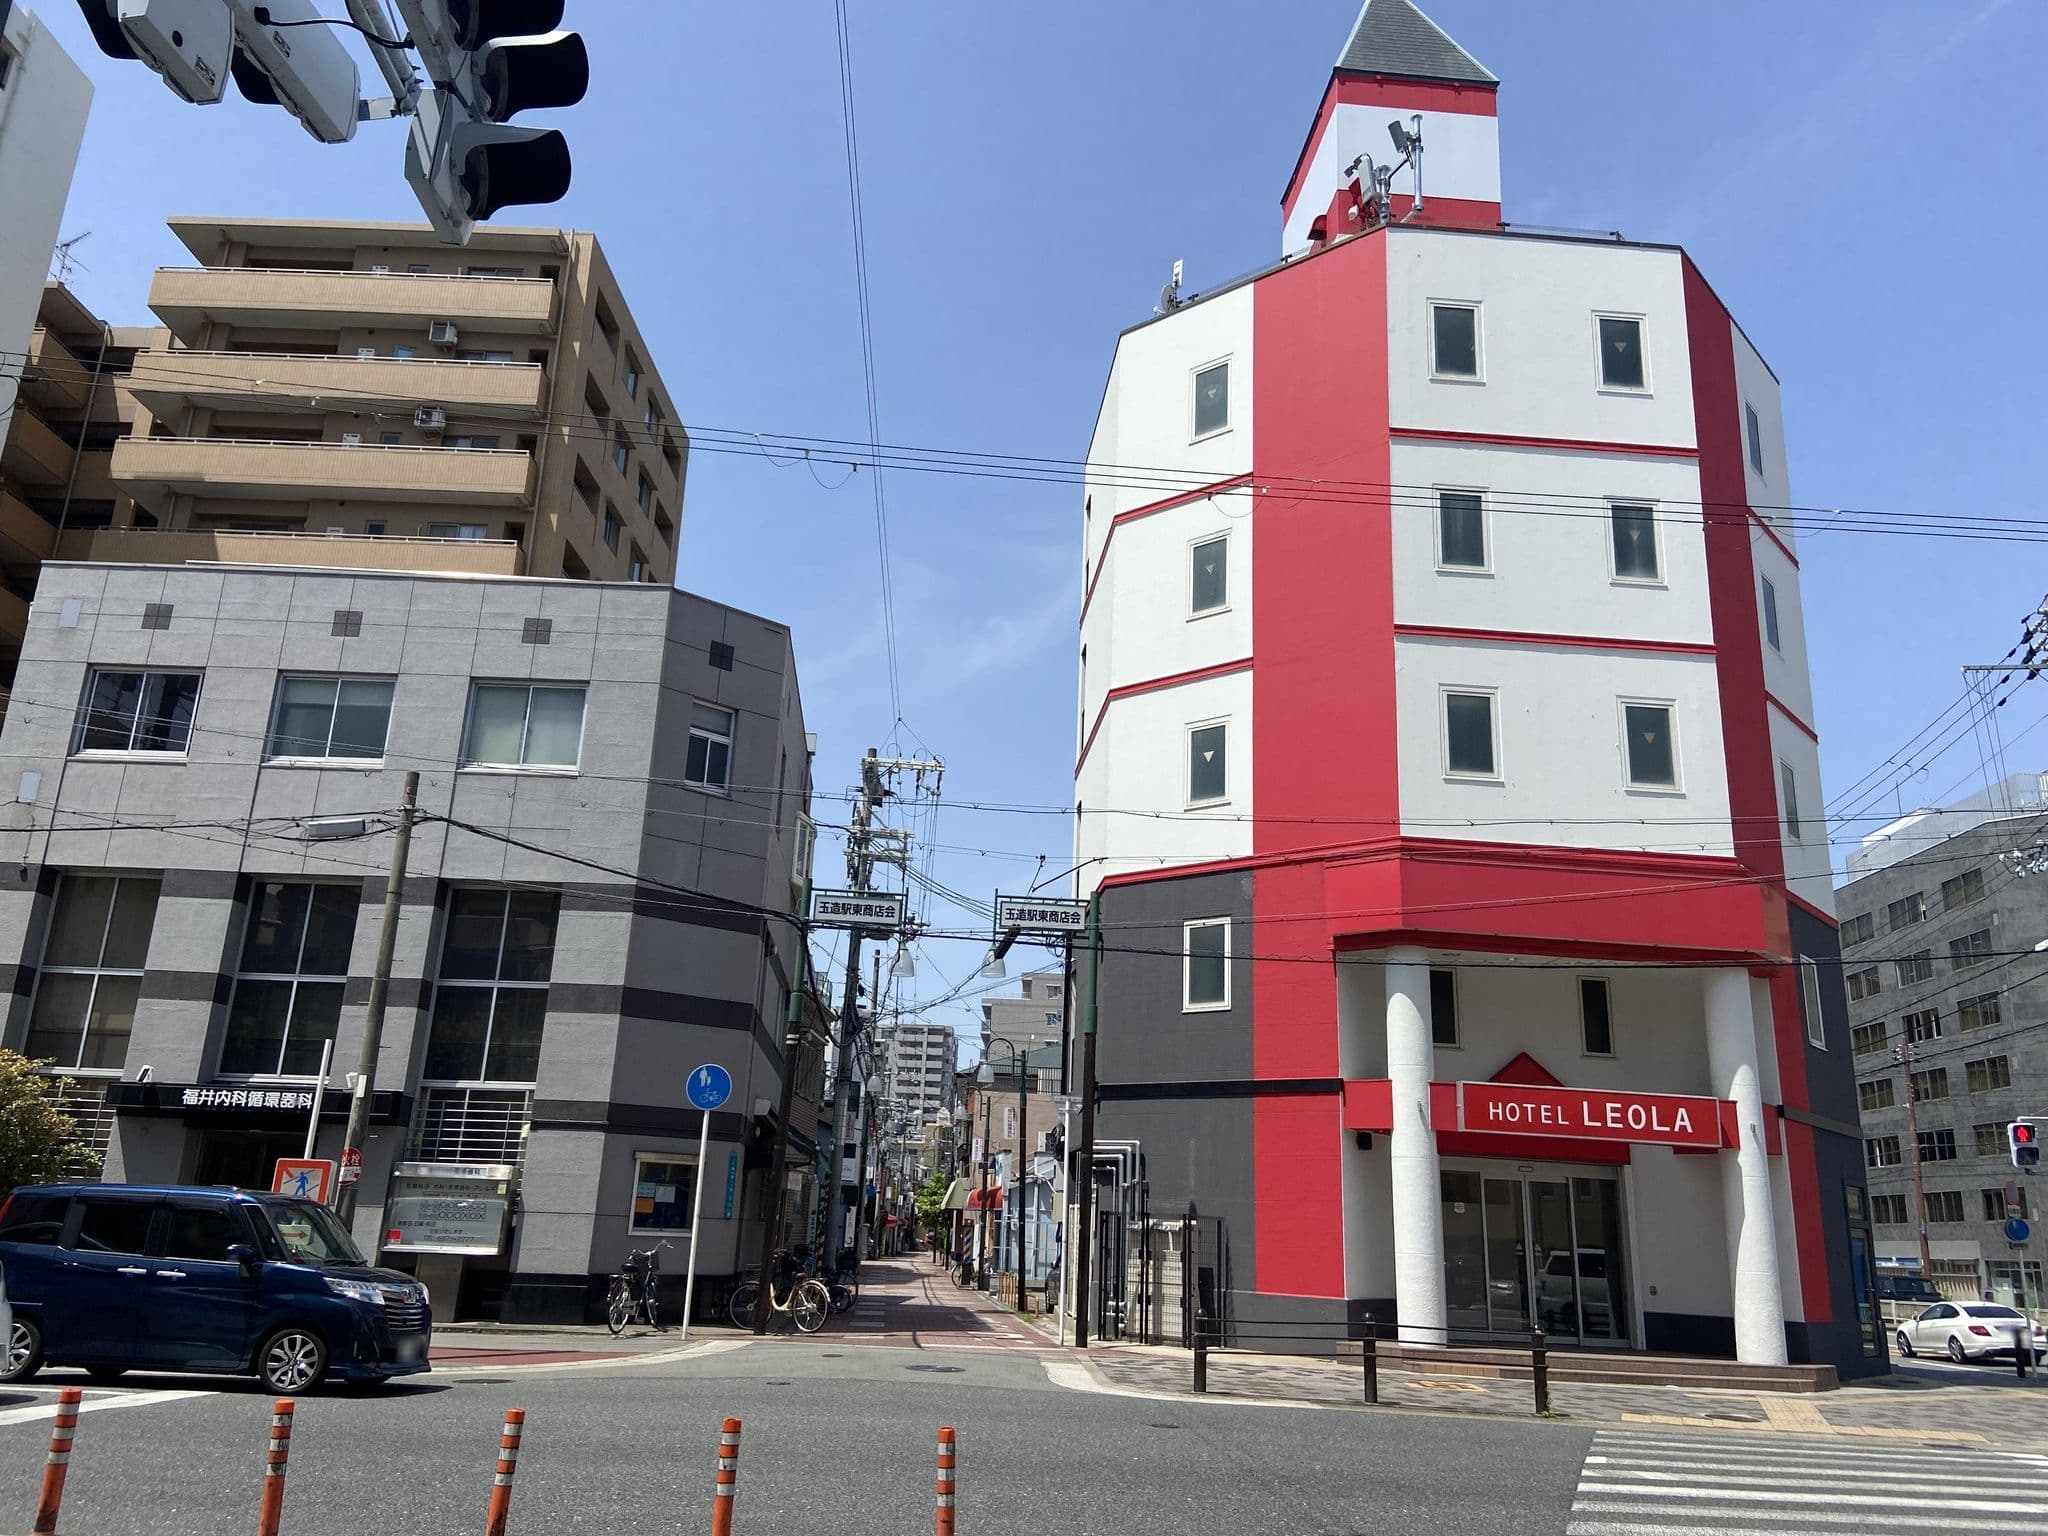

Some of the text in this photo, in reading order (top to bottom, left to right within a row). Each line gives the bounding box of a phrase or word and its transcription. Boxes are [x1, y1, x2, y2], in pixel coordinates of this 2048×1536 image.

[819, 901, 896, 918] 玉造駅東商店会
[1005, 908, 1081, 924] 玉造駅東商店会
[182, 1088, 313, 1109] 福井内科循環器科
[1489, 1100, 1693, 1133] HOTEL LEOLA
